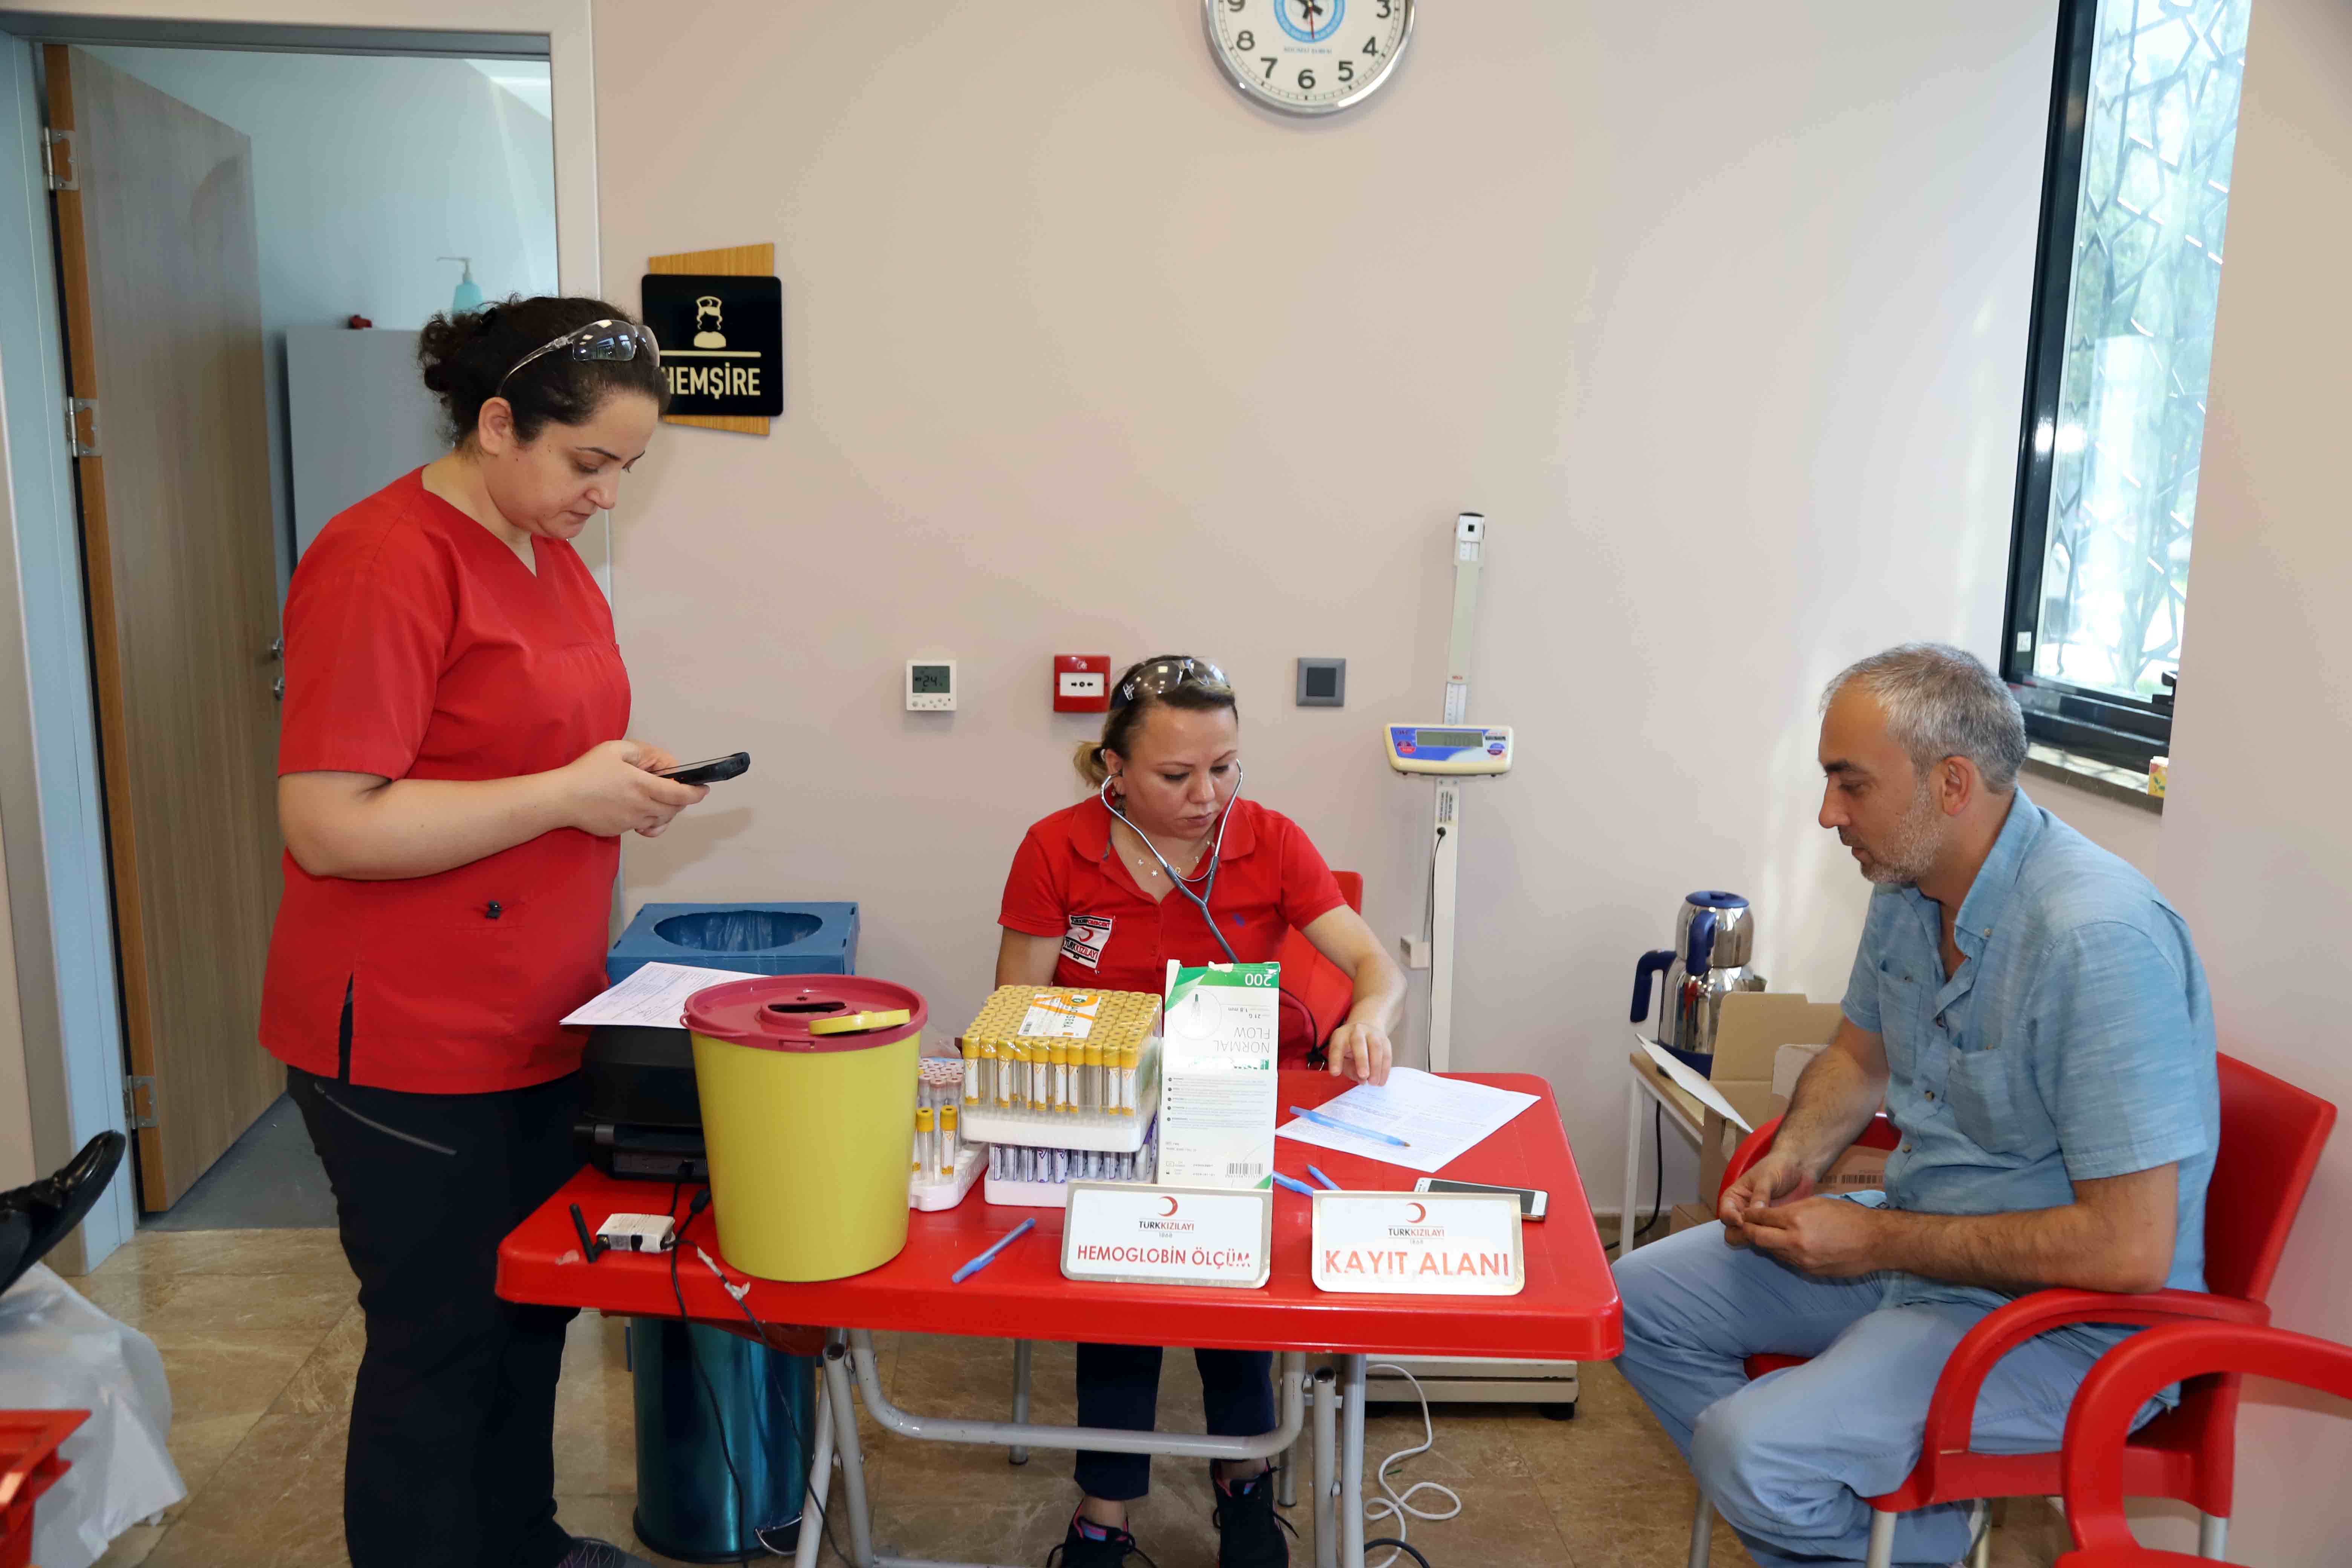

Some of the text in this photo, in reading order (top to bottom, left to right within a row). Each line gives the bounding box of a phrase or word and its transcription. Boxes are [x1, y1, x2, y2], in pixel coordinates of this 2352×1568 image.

[1377, 0, 1391, 18] 3
[1236, 31, 1255, 51] 8
[1363, 36, 1379, 56] 4
[1261, 57, 1277, 78] 7
[1338, 61, 1353, 81] 5
[1298, 70, 1315, 89] 6
[1245, 974, 1272, 986] 200
[1234, 1027, 1270, 1039] FLOW
[1213, 1040, 1269, 1053] NORMAL
[1077, 1245, 1186, 1264] HEMOGLOBİN
[1326, 1250, 1508, 1276] KAYIT ALANI
